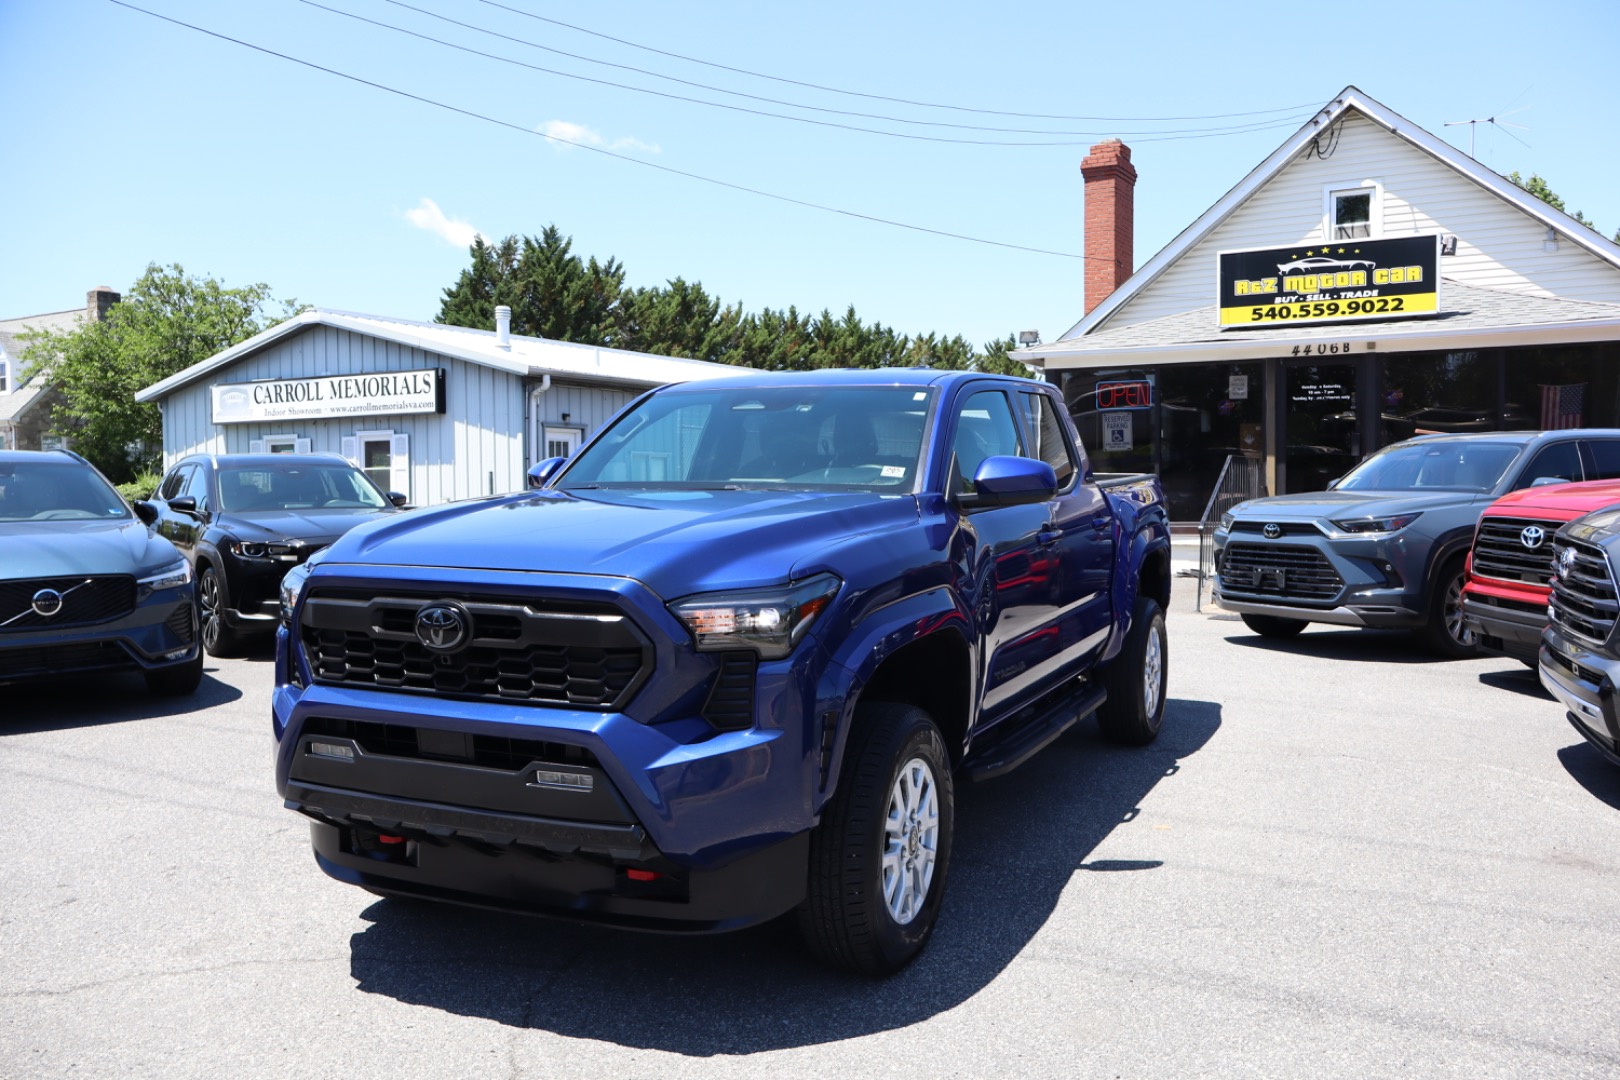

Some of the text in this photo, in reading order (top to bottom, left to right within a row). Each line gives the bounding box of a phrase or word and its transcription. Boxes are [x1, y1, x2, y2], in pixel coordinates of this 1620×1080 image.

[1274, 289, 1379, 304] BUY SELL TRADE
[1251, 298, 1404, 321] 540.559.9022
[253, 373, 431, 404] CARROLL MEMORIALS
[1098, 383, 1150, 407] OPEN
[264, 401, 434, 417] Indoor Showroom www.carrollmemorialsva.com
[1104, 415, 1131, 423] RESERVED
[1106, 422, 1128, 430] PARKING
